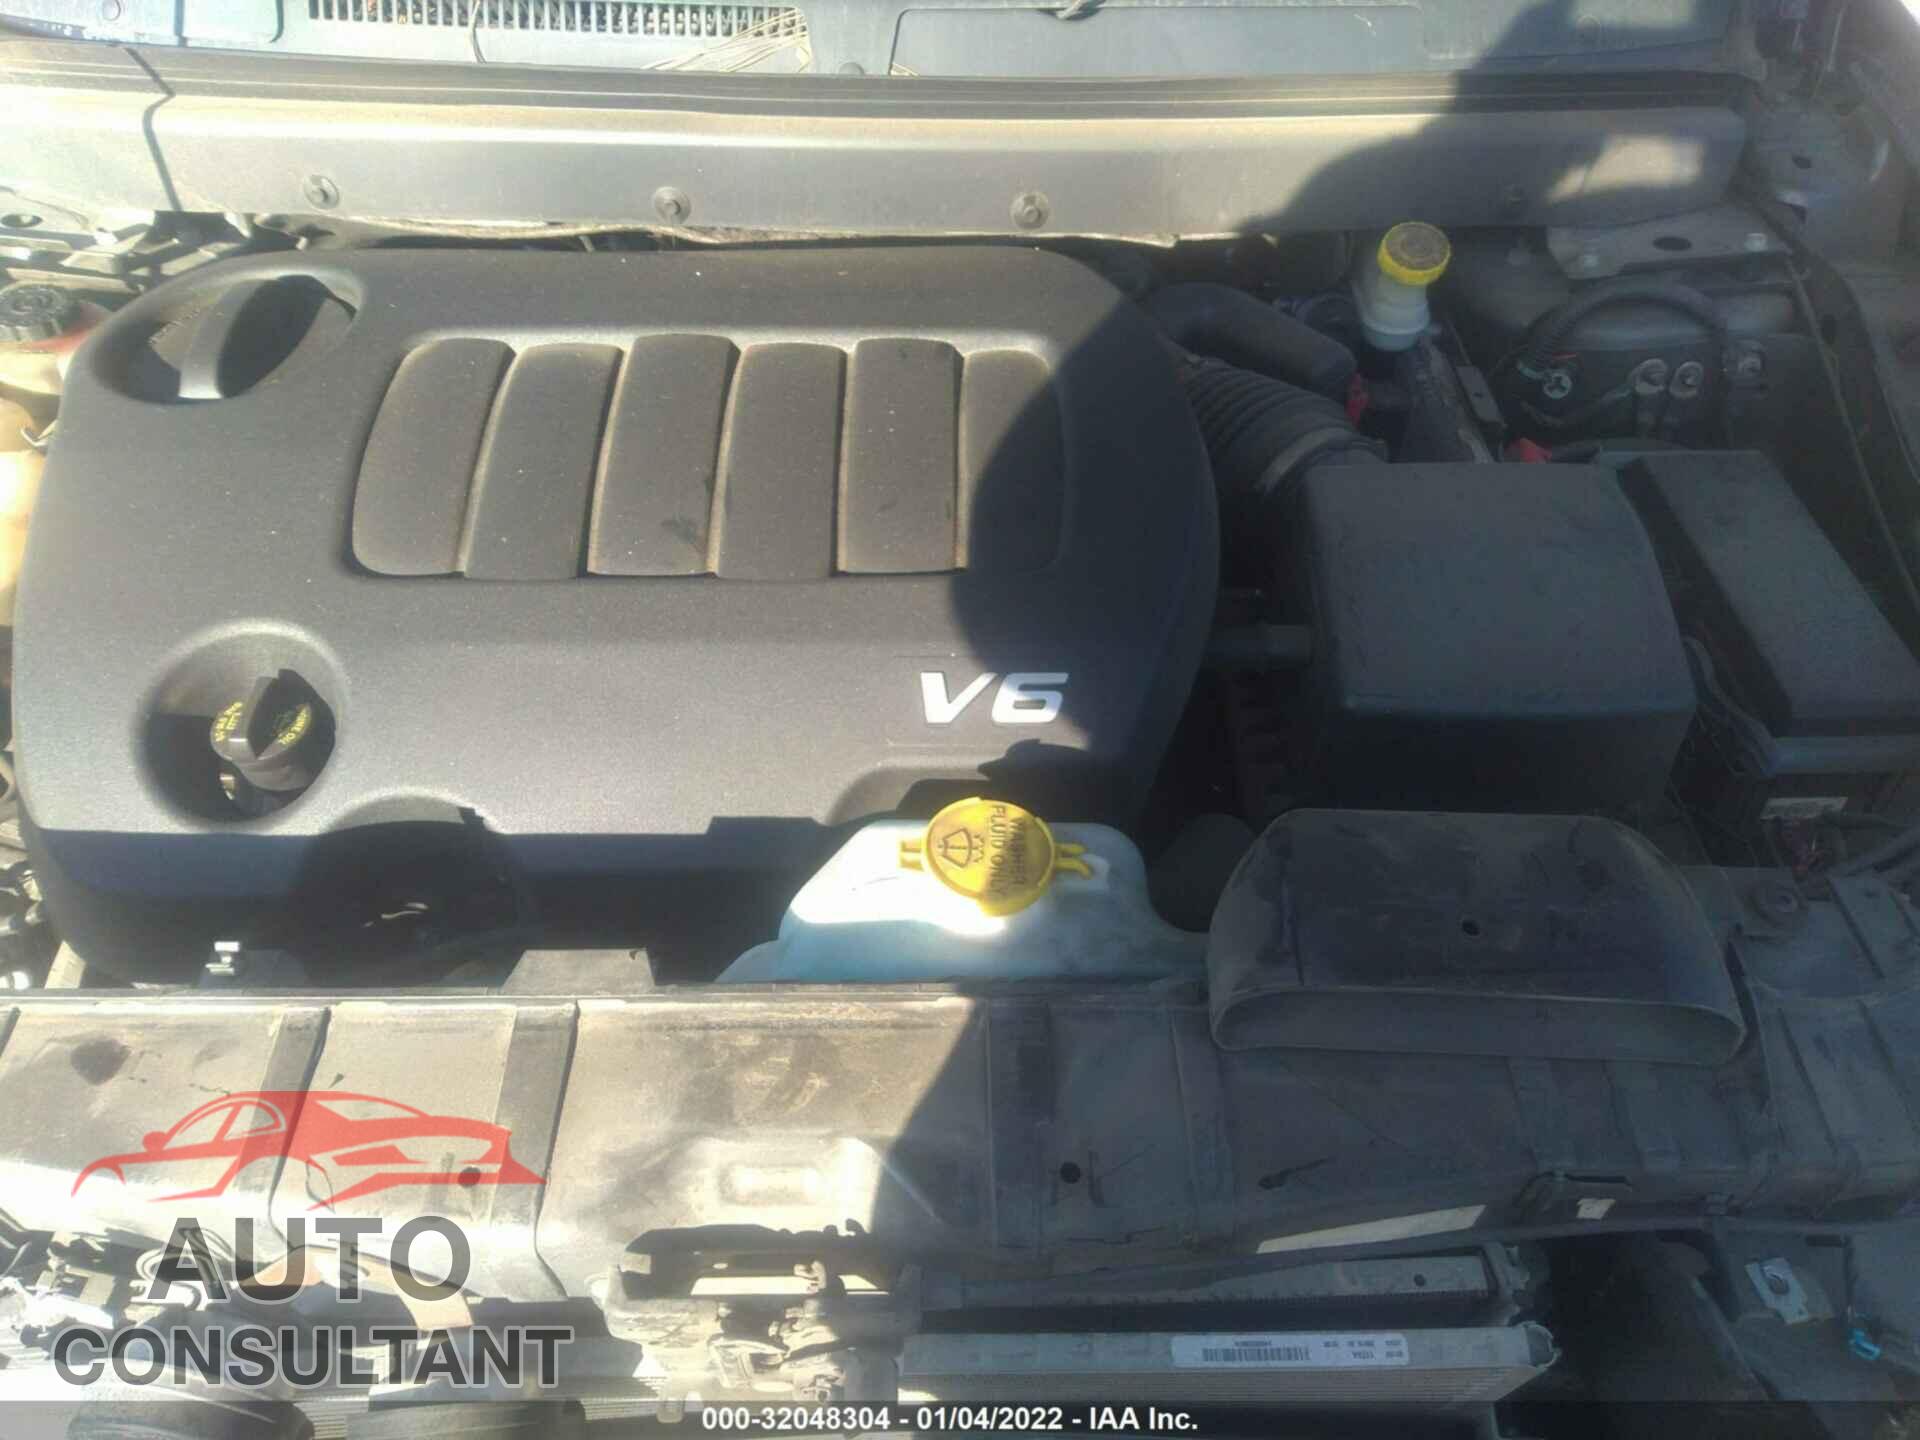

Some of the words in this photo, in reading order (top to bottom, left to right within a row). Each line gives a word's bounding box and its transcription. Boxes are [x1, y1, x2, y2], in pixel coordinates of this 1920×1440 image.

[920, 672, 1069, 723] V6
[990, 805, 1006, 849] FLUID
[989, 854, 1008, 896] ONLY
